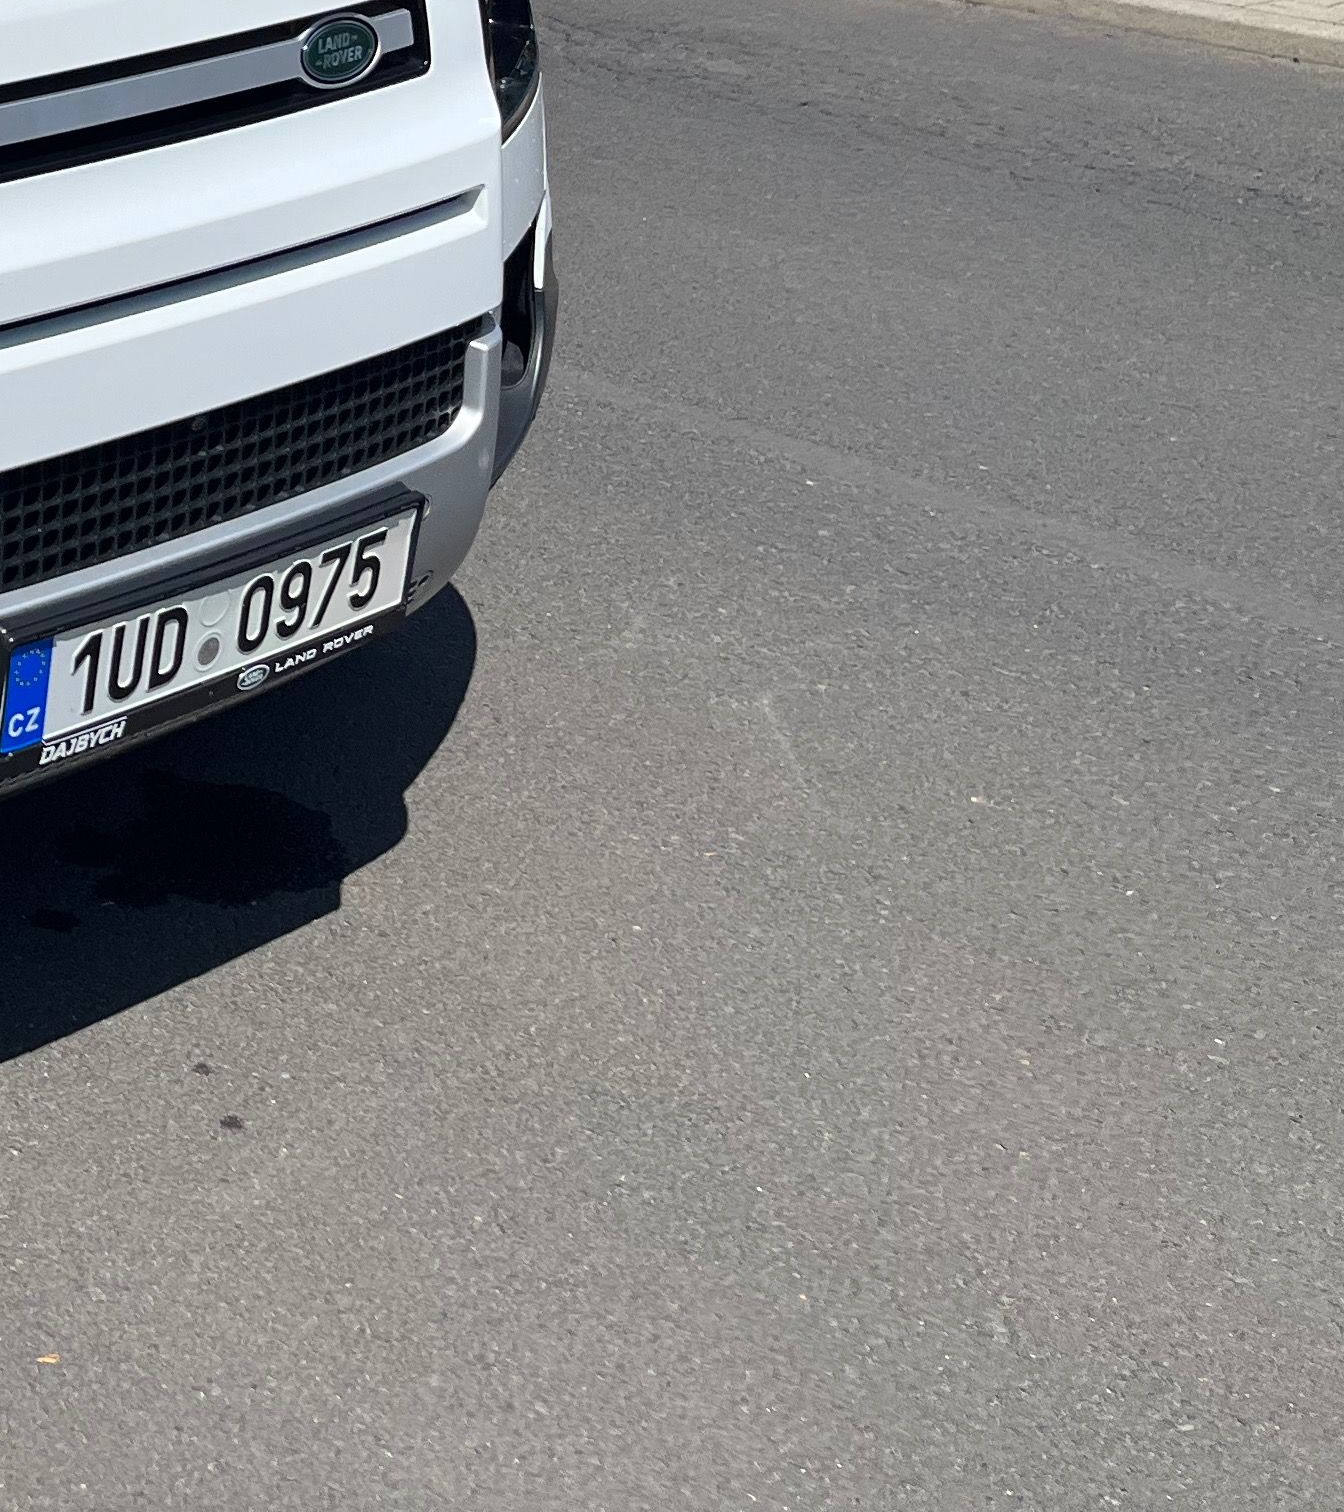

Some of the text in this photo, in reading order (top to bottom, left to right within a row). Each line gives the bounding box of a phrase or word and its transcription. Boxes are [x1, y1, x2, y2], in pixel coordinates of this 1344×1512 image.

[70, 525, 389, 717] 1UD 0975
[274, 623, 375, 674] LAND ROVER
[7, 705, 42, 738] CZ
[38, 720, 128, 766] DAJBYCH
